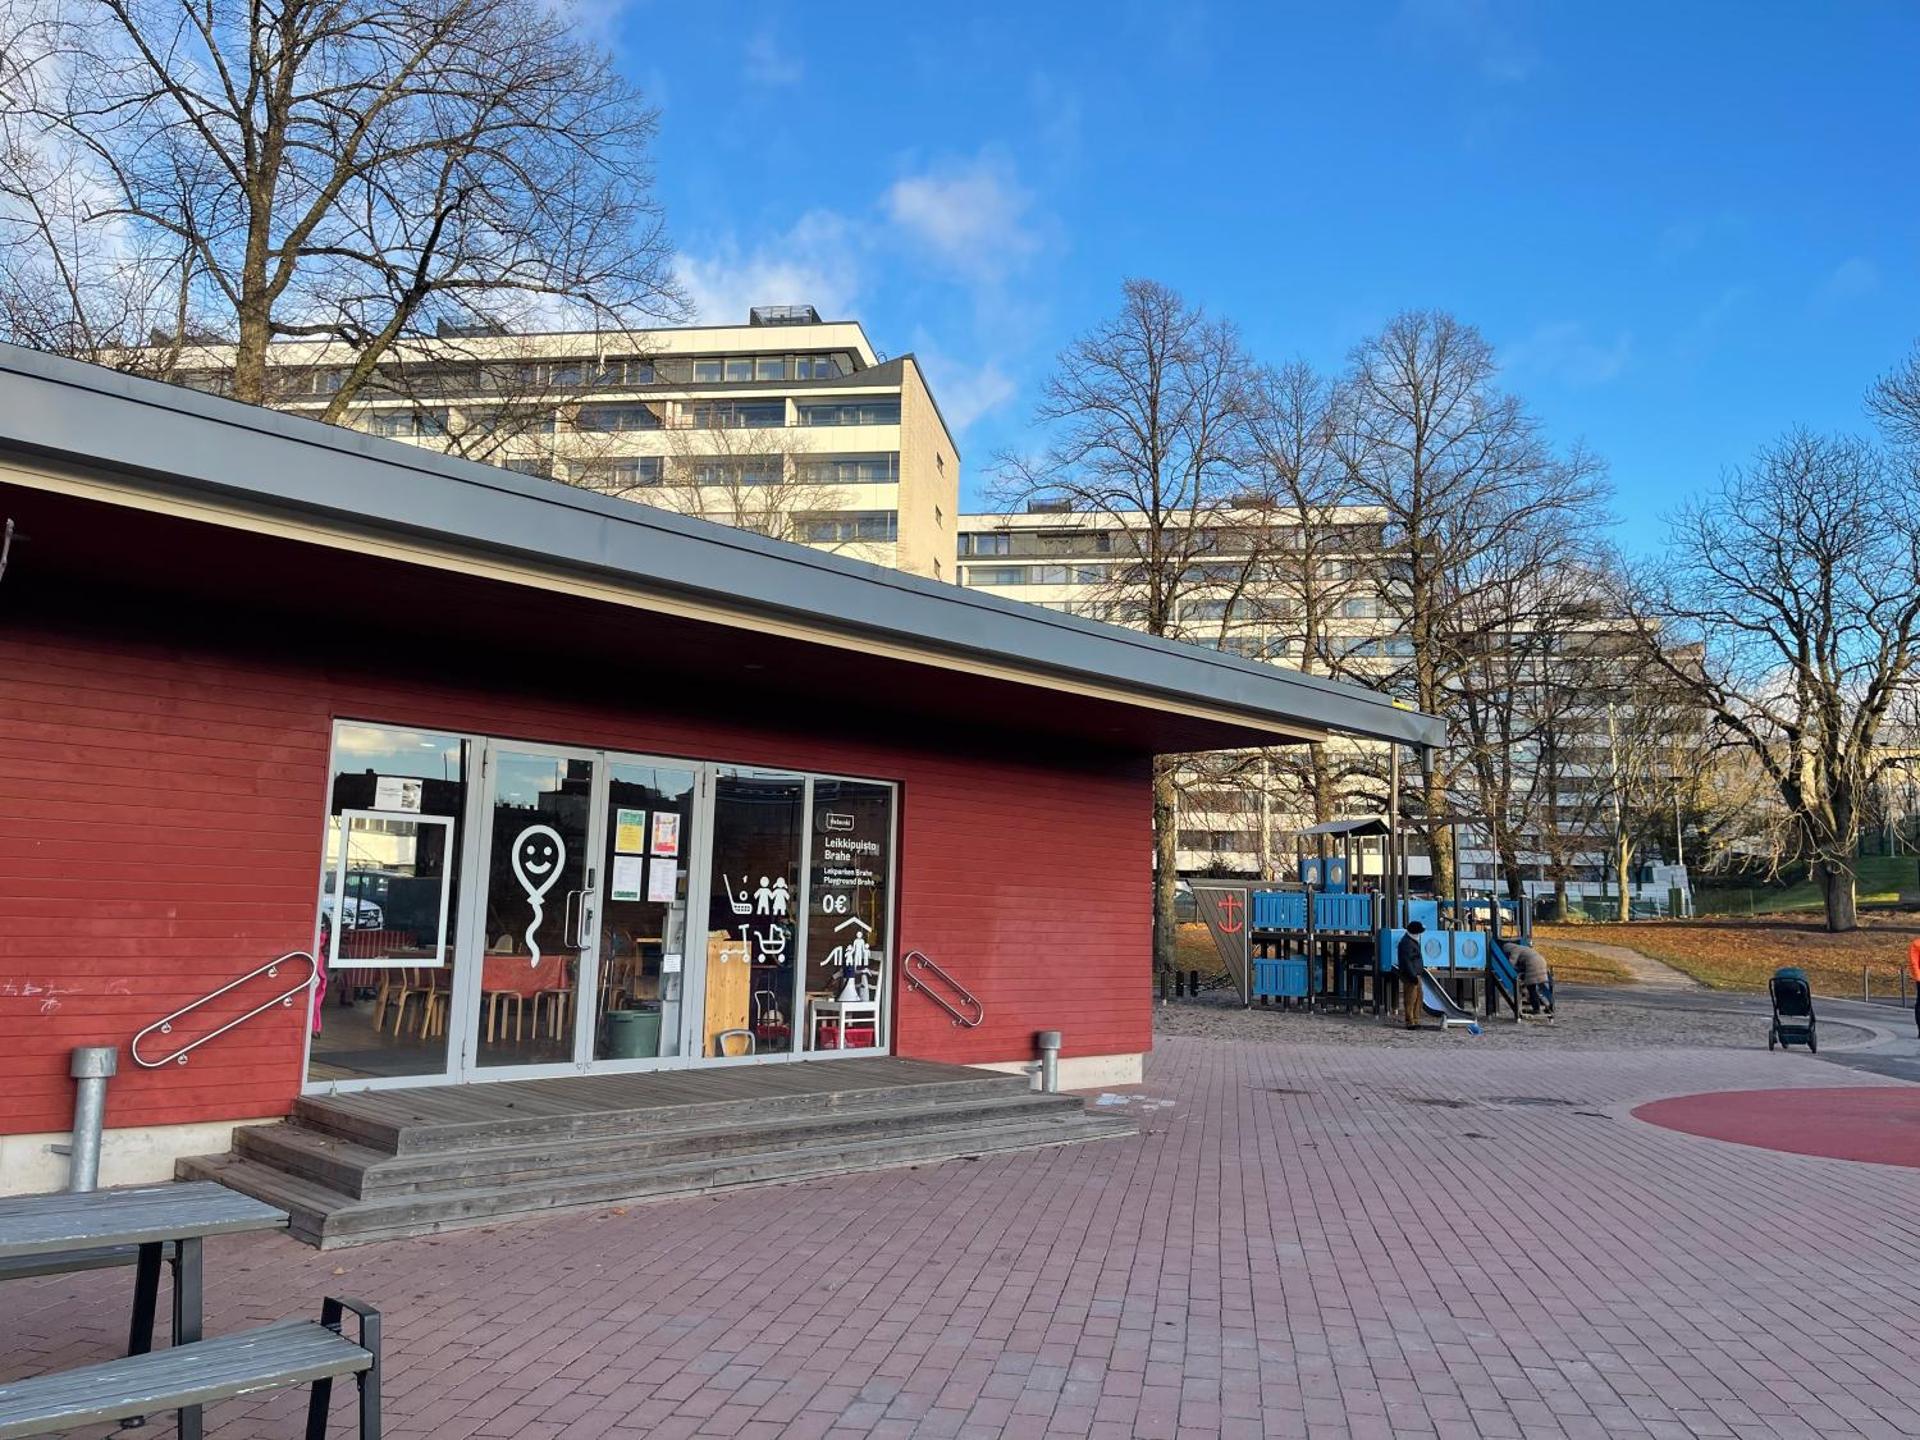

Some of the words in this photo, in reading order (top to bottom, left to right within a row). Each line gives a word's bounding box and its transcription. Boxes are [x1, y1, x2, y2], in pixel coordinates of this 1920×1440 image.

[824, 850, 851, 861] Brahe
[824, 876, 856, 886] Playground
[822, 894, 847, 914] 0€
